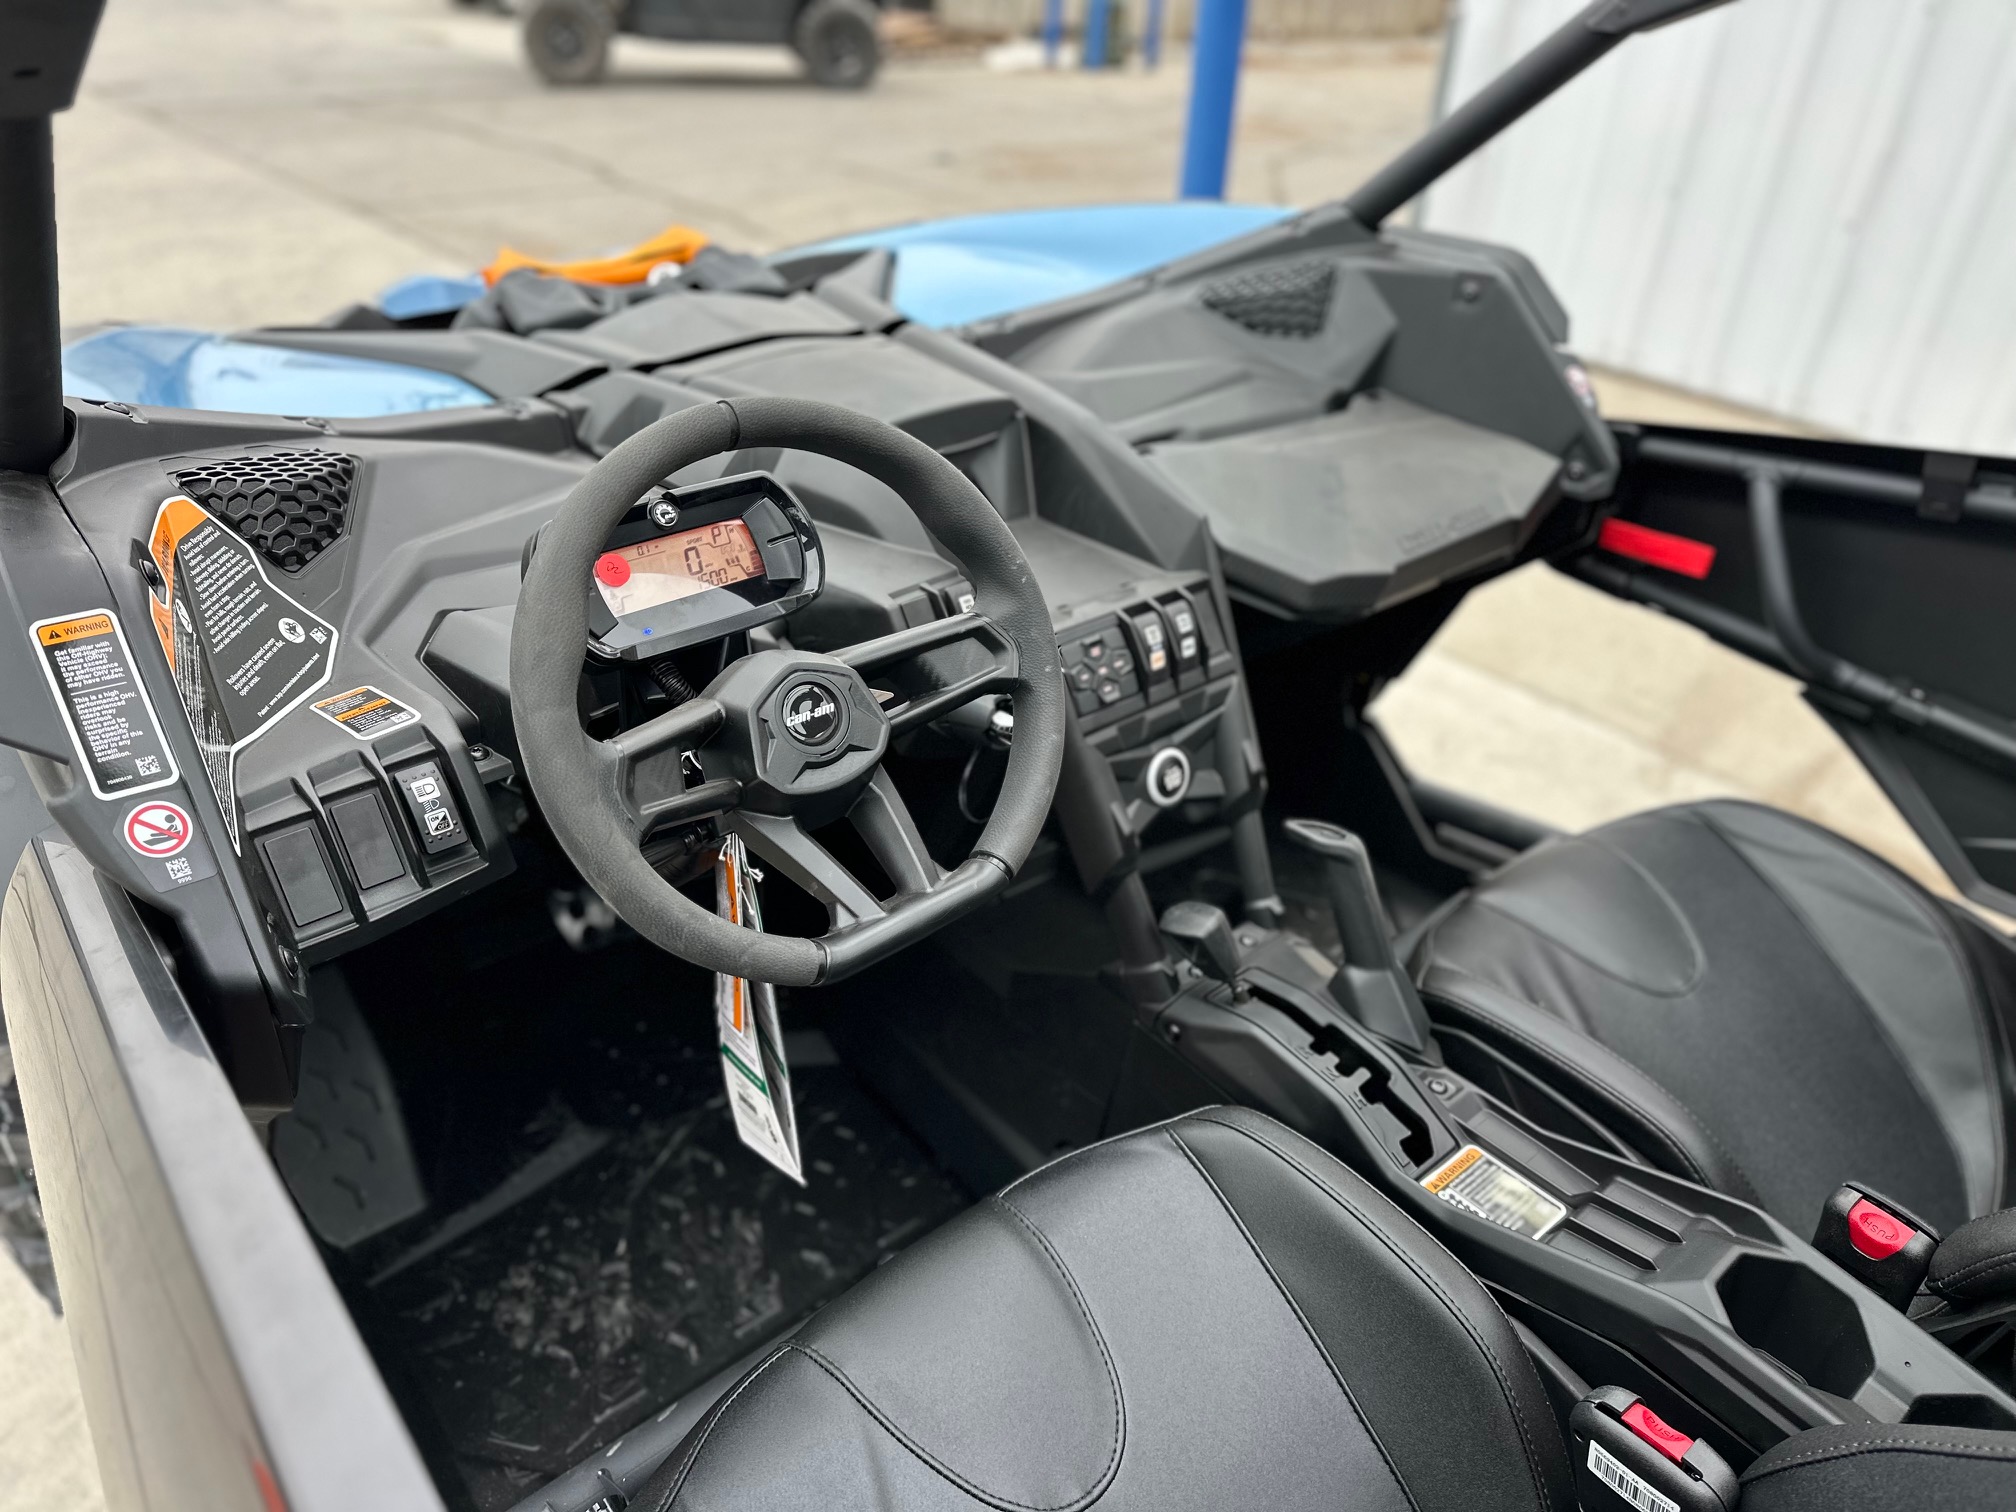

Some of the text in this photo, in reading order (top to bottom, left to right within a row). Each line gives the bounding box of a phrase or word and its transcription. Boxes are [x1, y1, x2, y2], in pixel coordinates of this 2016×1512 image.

[180, 526, 214, 552] Drive Responsibly
[684, 546, 703, 576] 0
[63, 620, 109, 636] WARNING
[68, 645, 94, 653] familiar
[76, 662, 118, 676] performance
[83, 658, 108, 667] exceed
[74, 673, 92, 681] other
[93, 669, 108, 677] OHV
[110, 667, 123, 675] you
[101, 673, 125, 681] ridden.
[76, 696, 119, 710] performance
[80, 708, 116, 720] riders may
[82, 714, 112, 725] overlook
[786, 702, 835, 727] can-am
[85, 723, 102, 731] risks
[87, 722, 129, 736] surprised by
[101, 729, 128, 738] specific
[91, 736, 120, 747] behavior
[95, 748, 119, 757] terrain
[97, 751, 131, 762] condition.
[1391, 1151, 1411, 1168] L
[1437, 1152, 1476, 1184] WARNING
[1862, 1217, 1896, 1241] PUSH
